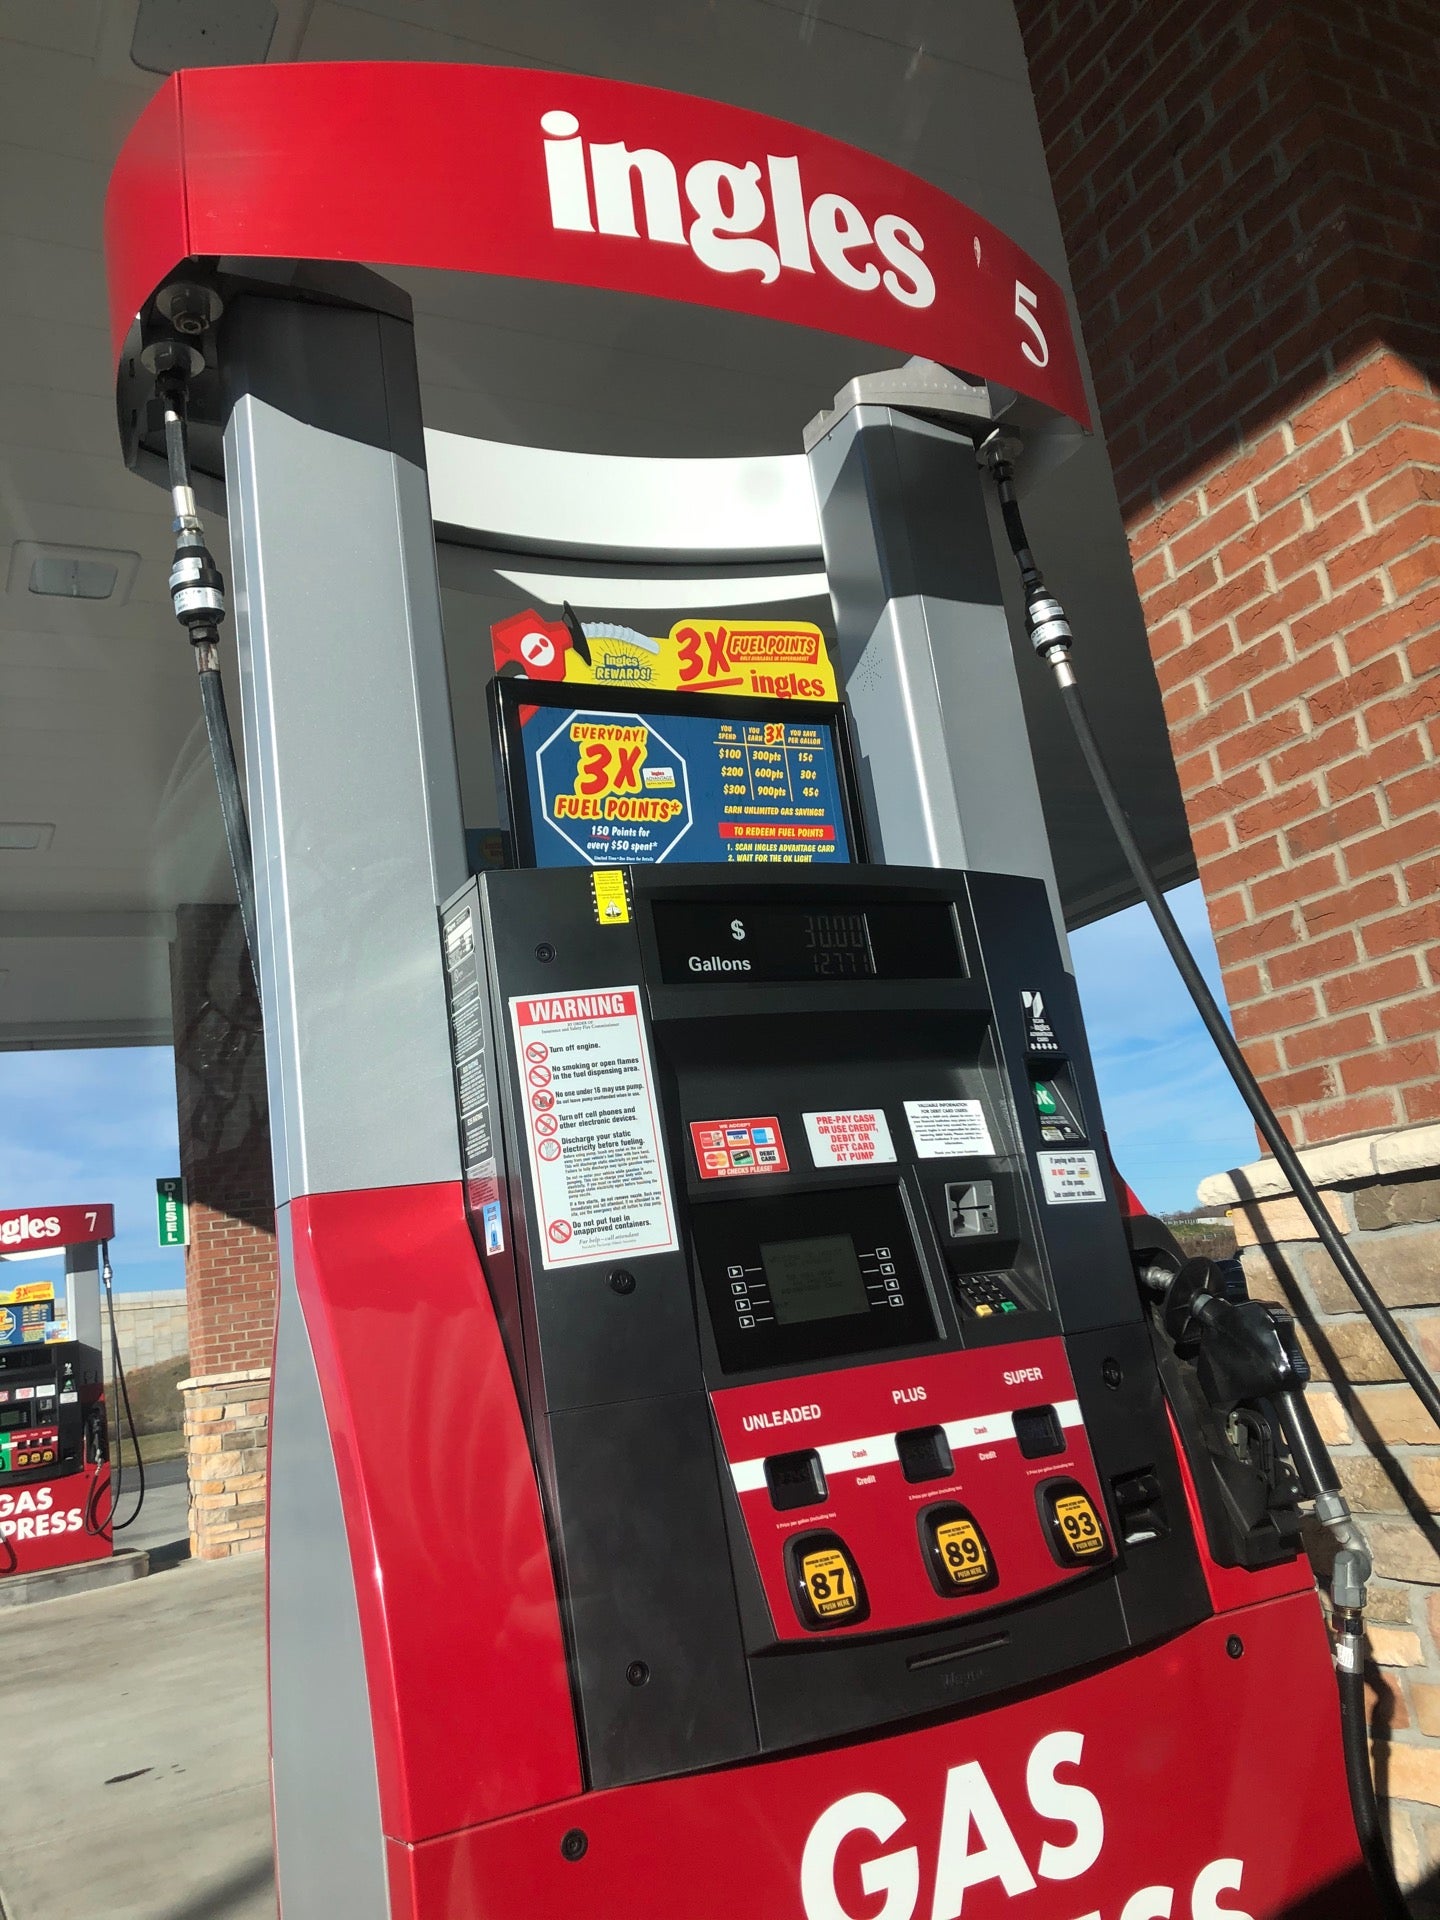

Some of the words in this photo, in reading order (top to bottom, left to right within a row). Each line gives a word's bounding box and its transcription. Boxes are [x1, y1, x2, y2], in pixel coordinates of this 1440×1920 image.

[541, 110, 935, 308] ingles
[1015, 280, 1049, 367] 5
[731, 636, 765, 655] FUEL
[767, 636, 816, 655] POINTS
[604, 654, 639, 667] ingles
[676, 627, 731, 681] 3X
[596, 667, 651, 681] REWARDS!
[750, 670, 825, 699] ingles
[573, 726, 646, 742] EVERYDAY!
[765, 724, 784, 743] 3X
[719, 748, 741, 759] $100
[752, 750, 781, 763] 300pts
[798, 752, 813, 762] 15¢
[581, 744, 641, 795] 3X
[721, 766, 743, 777] $200
[755, 768, 784, 781] 600pts
[800, 770, 816, 780] 30¢
[723, 784, 746, 795] $300
[757, 786, 786, 799] 900pts
[802, 787, 819, 798] 45¢
[557, 798, 600, 816] FUEL
[724, 806, 742, 814] EARN
[744, 806, 779, 815] UNLIMITED
[781, 807, 793, 816] GAS
[794, 808, 825, 817] SAVINGS!
[592, 825, 609, 835] 150
[611, 826, 636, 837] Points
[638, 826, 650, 837] for
[734, 826, 743, 835] TO
[746, 827, 775, 836] REDEEM
[778, 828, 795, 837] FUEL
[798, 828, 824, 837] POINTS
[587, 842, 609, 853] every
[611, 840, 629, 851] $50
[735, 843, 753, 851] SCAN
[779, 844, 815, 852] ADVANTAGE
[736, 854, 753, 862] WAIT
[794, 855, 812, 863] LIGHT
[730, 919, 746, 941] $
[688, 955, 752, 973] Gallons
[529, 994, 625, 1022] WARNING
[577, 1043, 600, 1051] engine.
[600, 1060, 615, 1068] open
[573, 1070, 586, 1078] fuel
[588, 1067, 622, 1077] dispensing
[576, 1088, 593, 1096] under
[626, 1083, 644, 1092] pump.
[574, 1112, 583, 1120] off
[585, 1110, 598, 1118] cell
[599, 1107, 623, 1117] phones
[816, 1115, 852, 1125] PRE-PAY
[853, 1113, 876, 1123] CASH
[560, 1122, 577, 1130] other
[579, 1117, 610, 1127] electronic
[612, 1114, 638, 1123] devices.
[818, 1126, 831, 1134] OR
[831, 1125, 848, 1134] USE
[849, 1123, 879, 1133] CREDIT,
[562, 1133, 595, 1145] Discharge
[596, 1133, 611, 1141] your
[612, 1130, 632, 1139] static
[831, 1133, 856, 1143] DEBIT
[858, 1133, 871, 1141] OR
[562, 1144, 596, 1153] electricity
[597, 1141, 619, 1149] before
[620, 1137, 645, 1146] fueling.
[831, 1143, 850, 1153] GIFT
[852, 1142, 875, 1151] CARD
[836, 1153, 848, 1162] AT
[849, 1151, 875, 1161] PUMP
[727, 1167, 749, 1175] CHECKS
[750, 1165, 773, 1173] PLEASE!
[164, 1182, 178, 1242] DIESEL
[0, 1214, 61, 1245] gles
[85, 1212, 97, 1232] 7
[573, 1224, 613, 1236] unapproved
[614, 1220, 651, 1230] containers.
[583, 1219, 595, 1227] not
[596, 1218, 608, 1227] put
[1003, 1367, 1043, 1386] SUPER
[892, 1386, 927, 1405] PLUS
[743, 1404, 821, 1432] UNLEADED
[973, 1426, 988, 1435] Cash
[852, 1449, 867, 1459] Cash
[978, 1450, 997, 1461] Credit
[856, 1475, 877, 1486] Credit
[0, 1487, 53, 1517] GAS
[1064, 1512, 1097, 1540] 93
[945, 1537, 980, 1567] 89
[811, 1567, 845, 1600] 87
[822, 1602, 837, 1611] PUSH
[837, 1598, 850, 1608] HERE
[801, 1731, 1104, 1920] GAS
